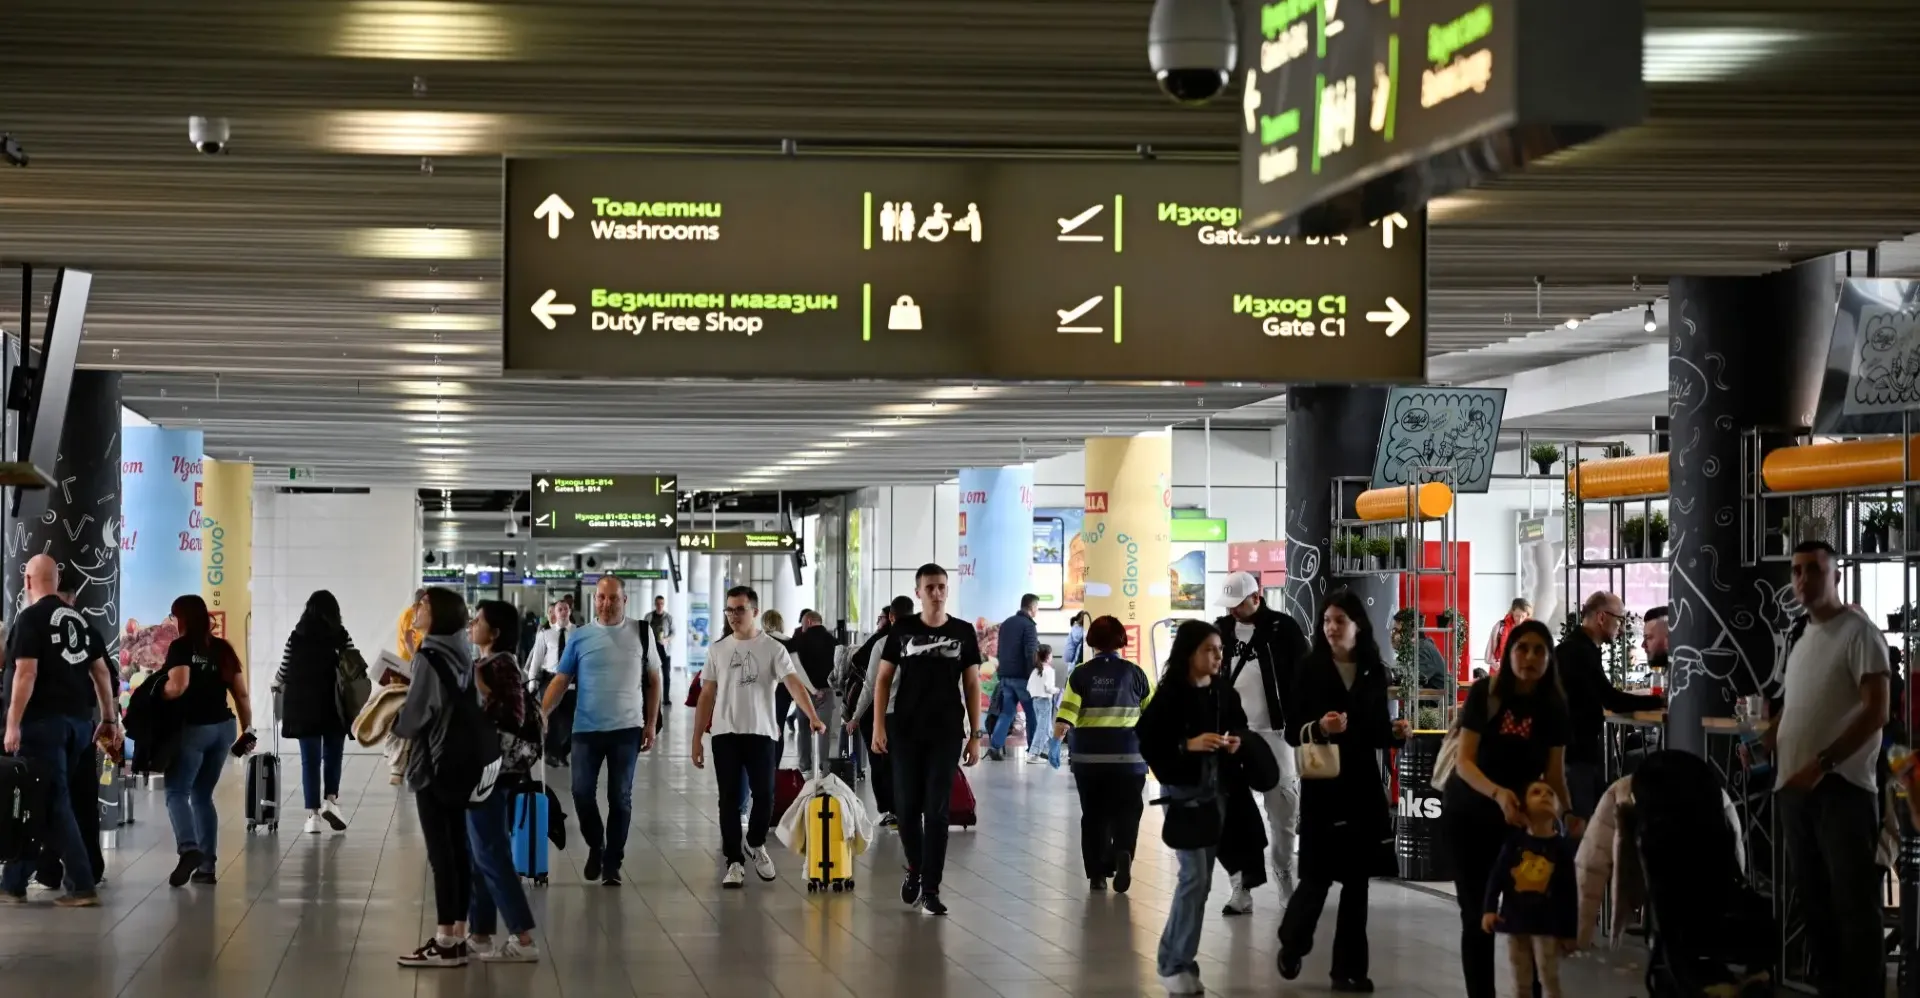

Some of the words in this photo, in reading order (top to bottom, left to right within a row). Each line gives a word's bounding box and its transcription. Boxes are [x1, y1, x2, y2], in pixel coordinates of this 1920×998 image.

[591, 196, 721, 218] Тоалетни
[1158, 201, 1241, 227] Изход
[591, 220, 720, 241] Washrooms
[591, 289, 724, 312] Безмитен
[730, 295, 838, 314] магазин
[1232, 294, 1312, 316] Изход
[1317, 294, 1347, 315] C1
[591, 312, 644, 335] Duty
[652, 312, 701, 332] Free
[705, 312, 763, 336] Shop
[1262, 317, 1315, 337] Gate
[1320, 318, 1346, 337] C1
[554, 478, 584, 487] Изходи
[554, 485, 575, 493] Gates
[207, 526, 225, 586] Glovo
[1122, 541, 1139, 597] Glovo
